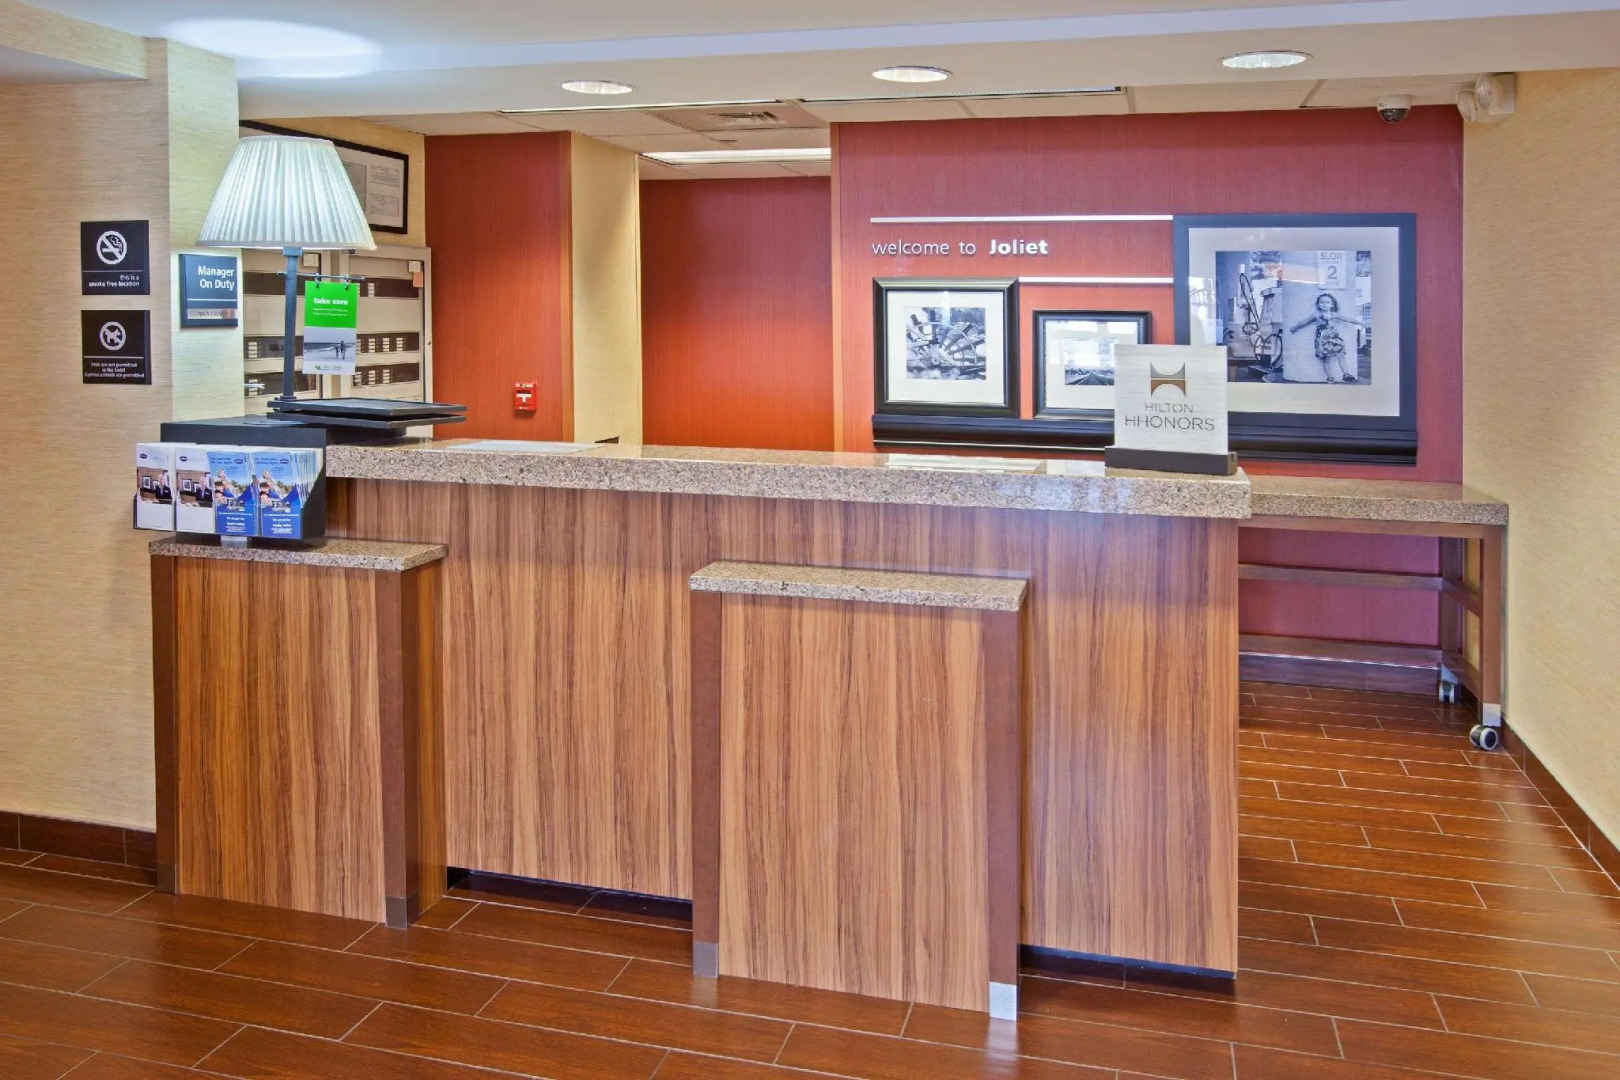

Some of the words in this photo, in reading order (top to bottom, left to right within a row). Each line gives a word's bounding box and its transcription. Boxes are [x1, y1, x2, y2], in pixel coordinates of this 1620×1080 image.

[872, 239, 949, 255] welcome
[959, 241, 976, 255] to
[989, 239, 1048, 255] Joliet
[1320, 251, 1344, 260] SLOW
[197, 265, 235, 278] Manager
[1327, 265, 1337, 280] 2
[200, 279, 213, 289] On
[214, 279, 235, 291] Duty
[1145, 402, 1194, 413] HILTON
[1125, 414, 1215, 431] HHONORS
